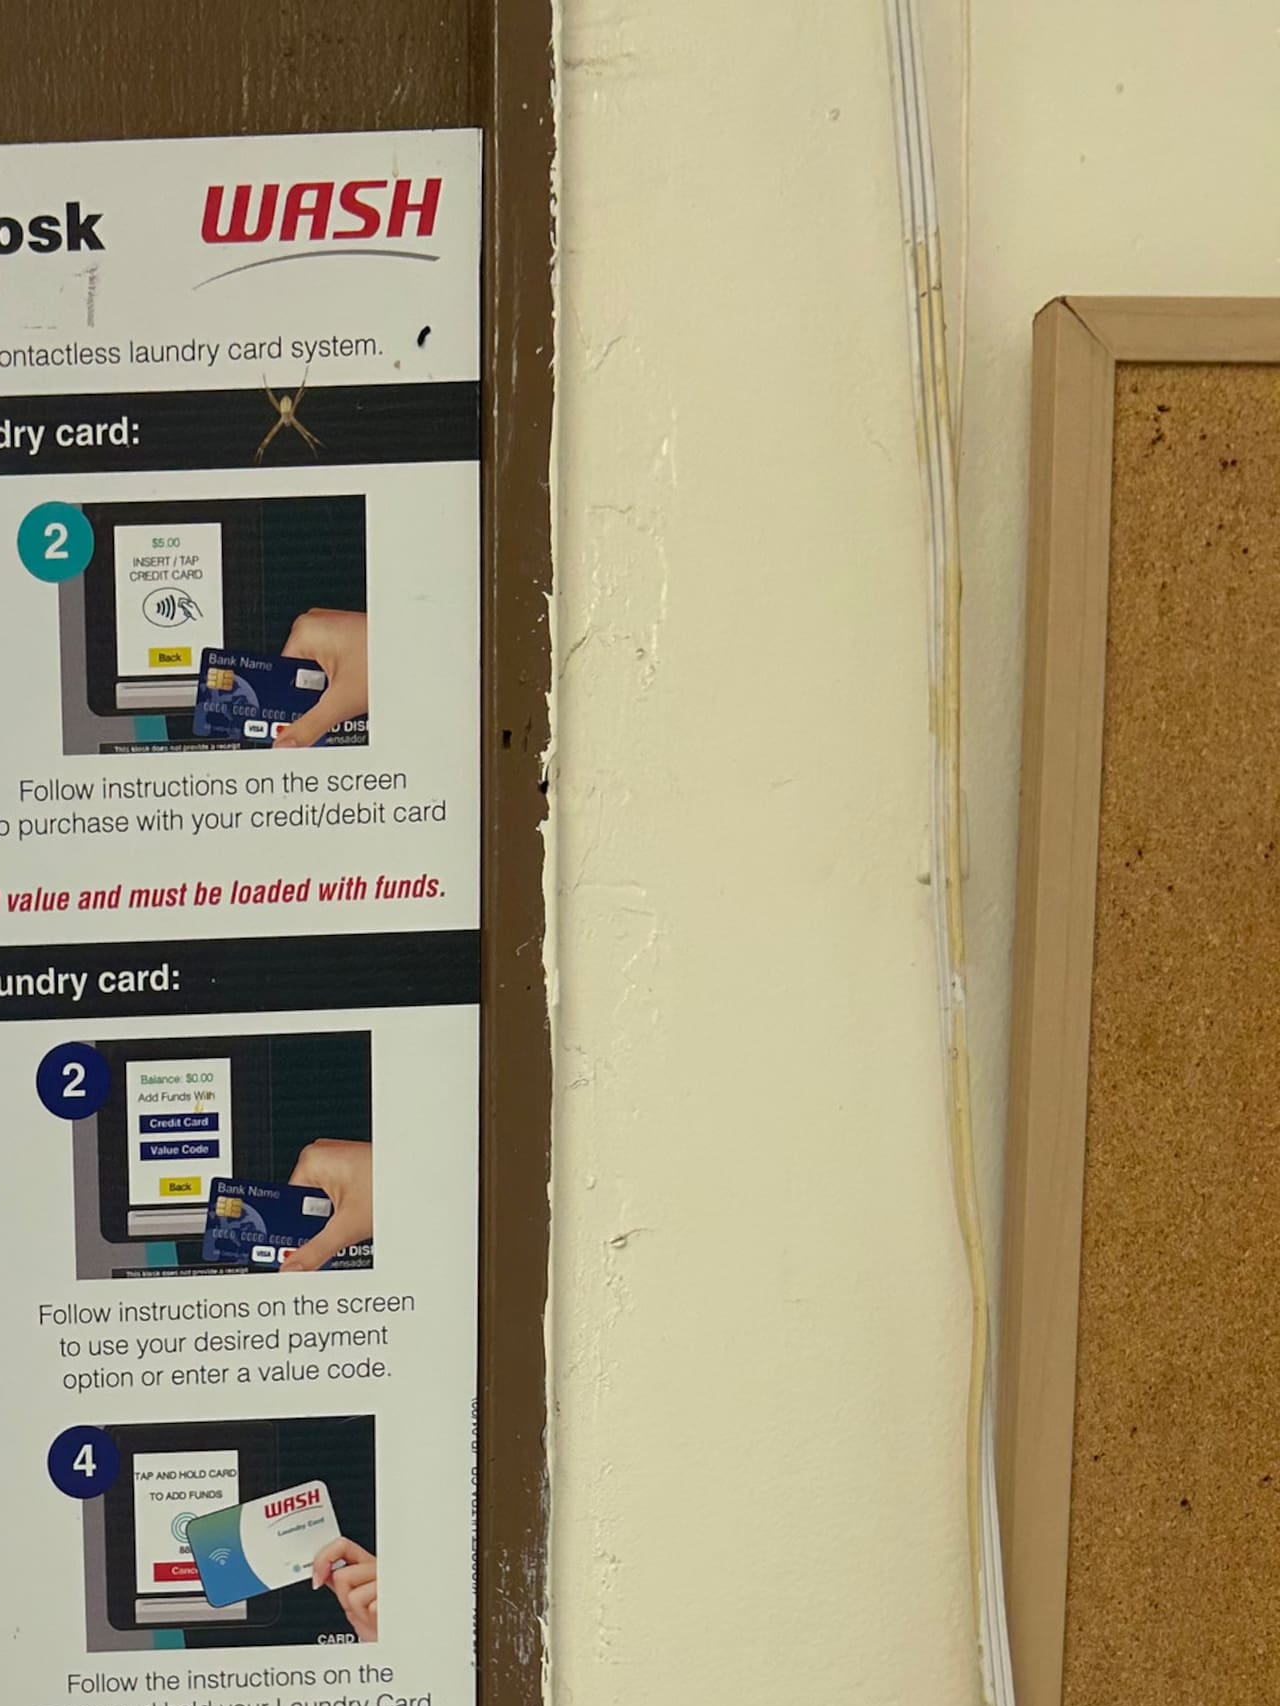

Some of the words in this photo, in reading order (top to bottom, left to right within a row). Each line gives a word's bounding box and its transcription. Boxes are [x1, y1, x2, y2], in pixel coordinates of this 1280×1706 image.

[201, 177, 442, 244] WASH
[128, 340, 219, 366] laundry
[227, 337, 282, 360] card
[291, 336, 383, 362] system.
[55, 416, 140, 449] card:
[43, 521, 69, 560] 2
[129, 571, 169, 582] CREDIT
[171, 569, 204, 580] CARD
[132, 557, 170, 568] INSERT
[180, 555, 200, 566] TAP
[208, 653, 237, 666] Bank
[239, 657, 272, 671] Name
[20, 778, 94, 802] Follow
[102, 775, 238, 800] instructions
[245, 775, 274, 796] on
[282, 772, 319, 794] the
[326, 770, 407, 792] screen
[6, 887, 69, 912] value
[77, 884, 121, 910] and
[128, 883, 186, 908] must
[193, 881, 222, 906] be
[230, 878, 311, 905] loaded
[318, 876, 367, 902] with
[374, 874, 446, 900] funds.
[98, 963, 180, 994] card:
[61, 1062, 87, 1098] 2
[138, 1092, 159, 1103] Add
[161, 1091, 192, 1102] Funds
[149, 1118, 181, 1128] Credit
[183, 1117, 209, 1127] Card
[150, 1145, 180, 1155] Value
[181, 1144, 209, 1154] Code
[38, 1303, 111, 1326] Follow
[119, 1297, 250, 1323] instructions
[256, 1298, 286, 1318] on
[292, 1294, 329, 1316] the
[336, 1293, 415, 1314] screen
[60, 1336, 81, 1357] to
[88, 1336, 129, 1357] use
[136, 1335, 186, 1359] your
[194, 1329, 280, 1353] desired
[287, 1324, 388, 1354] payment
[72, 1443, 97, 1479] 4
[135, 1471, 154, 1481] TAP
[155, 1470, 177, 1480] AND
[179, 1469, 207, 1479] HOLD
[208, 1468, 237, 1478] CARD
[264, 1488, 321, 1519] WASH
[67, 1672, 139, 1694] Follow
[144, 1670, 180, 1691] the
[187, 1666, 316, 1690] instructions
[323, 1666, 352, 1685] on
[358, 1663, 394, 1684] the
